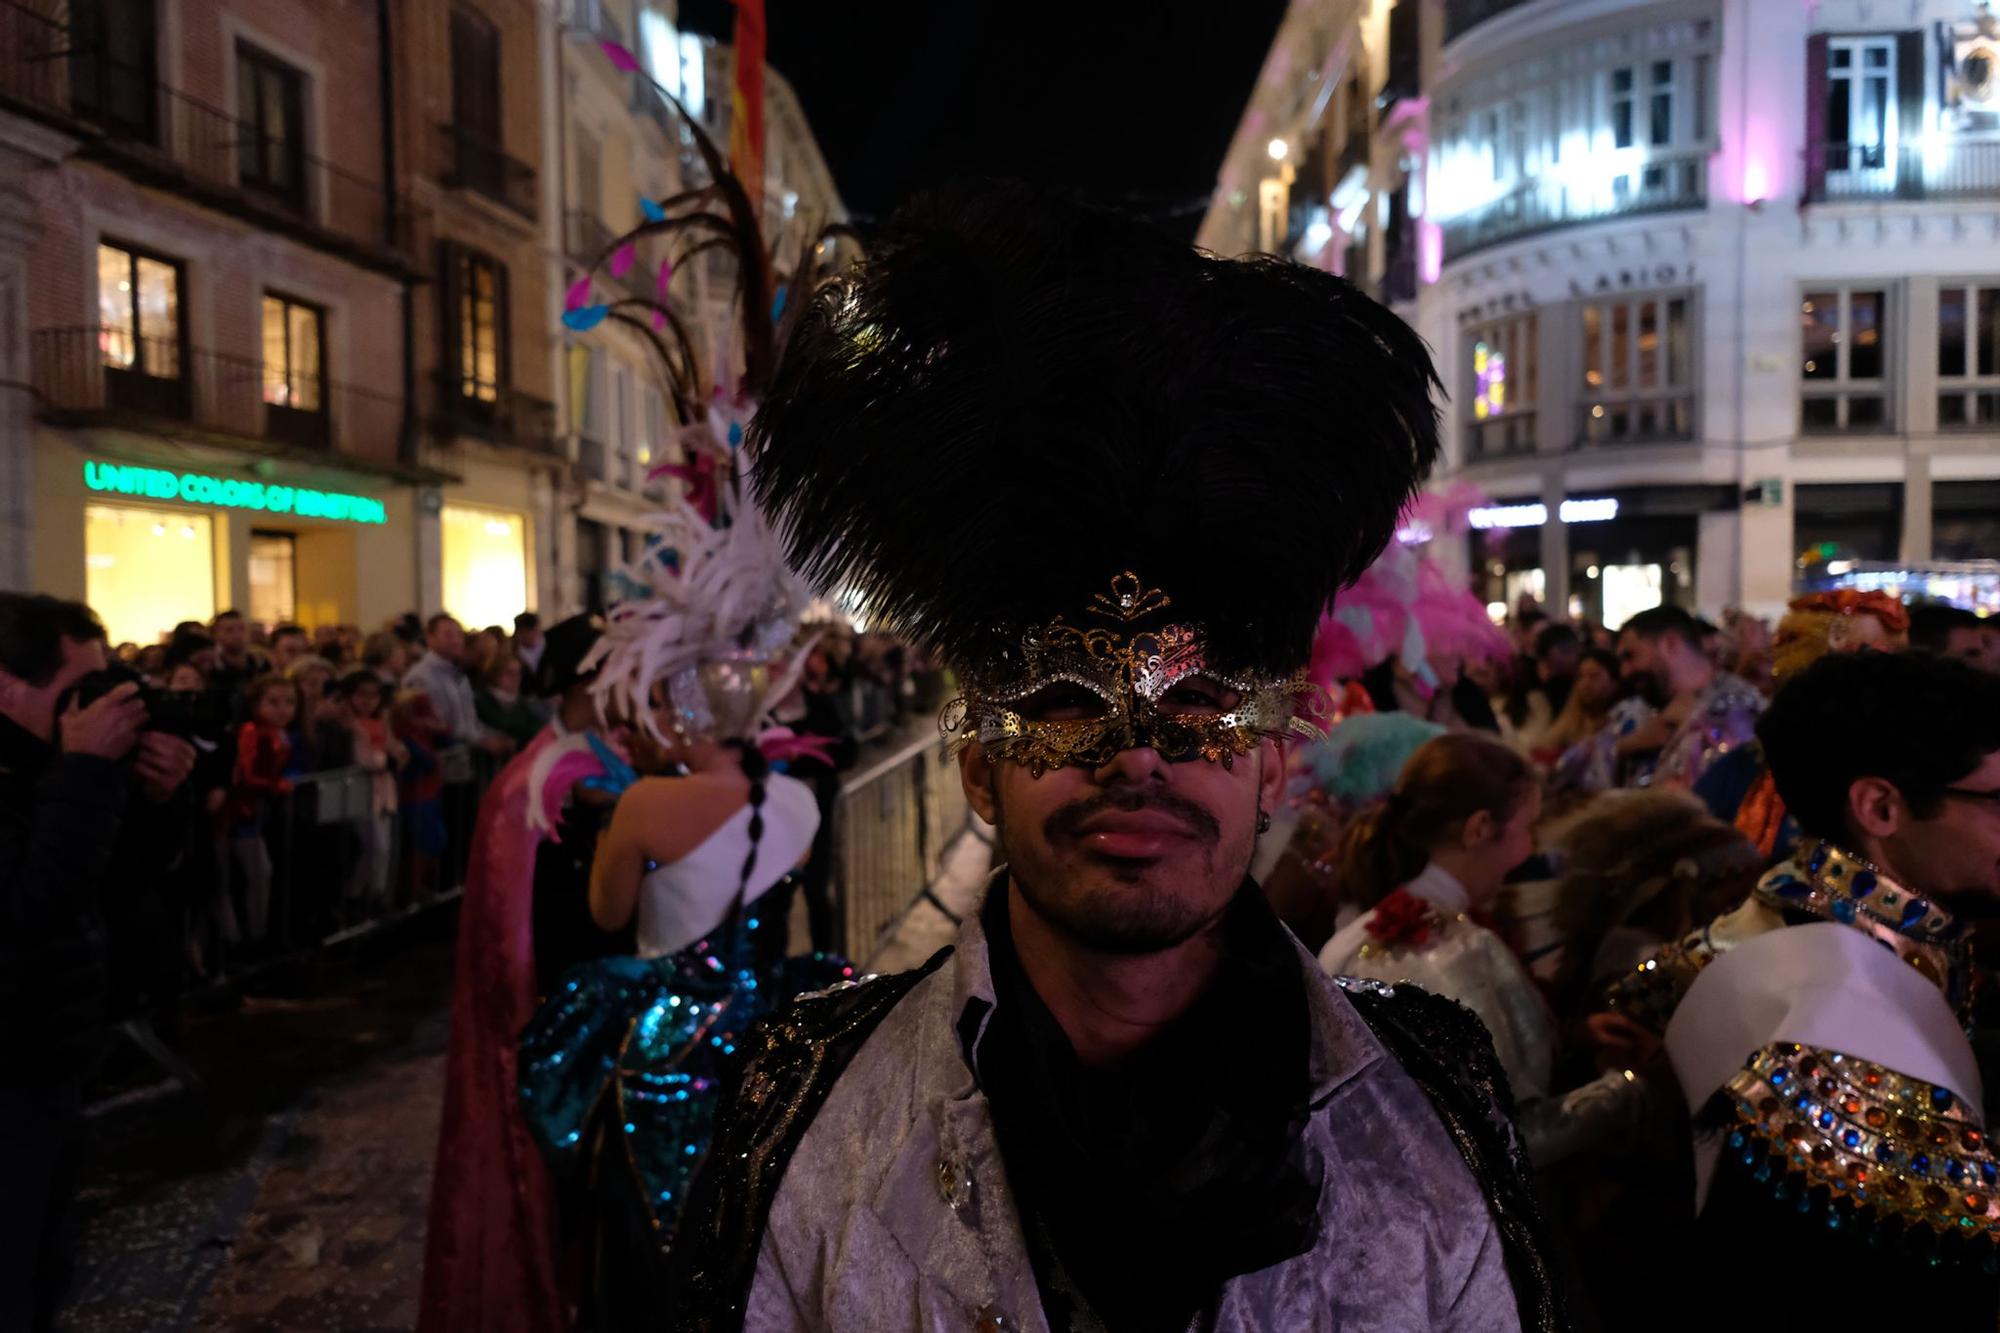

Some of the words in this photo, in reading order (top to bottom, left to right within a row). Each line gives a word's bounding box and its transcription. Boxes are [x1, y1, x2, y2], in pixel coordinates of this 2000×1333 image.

[84, 461, 178, 498] UNITED
[179, 474, 265, 509] COLORS
[266, 485, 293, 513] OF
